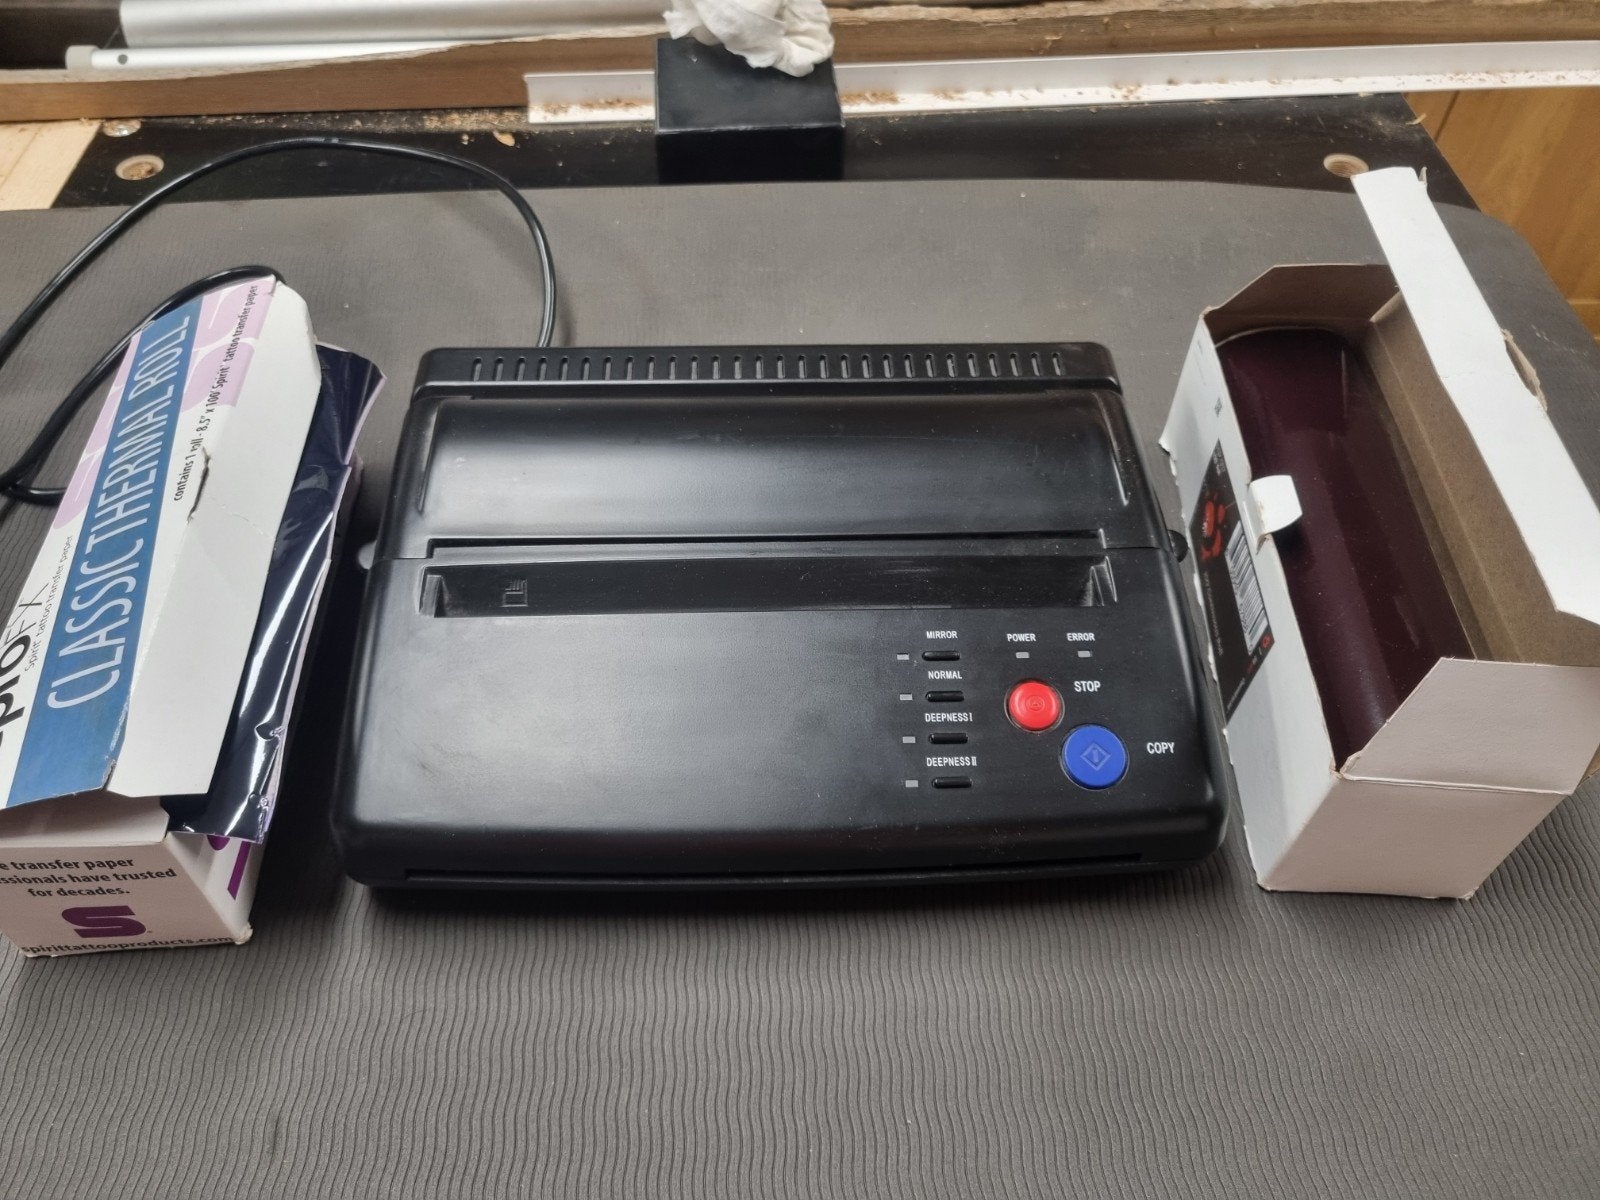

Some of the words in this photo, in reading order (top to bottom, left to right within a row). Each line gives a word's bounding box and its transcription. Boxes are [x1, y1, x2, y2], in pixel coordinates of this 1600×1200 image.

[243, 285, 258, 309] paper
[232, 308, 250, 338] transfer
[224, 335, 241, 362] tattoo
[128, 315, 191, 401] ROLL
[190, 439, 204, 453] roll
[86, 384, 175, 554] THERMAL
[174, 462, 194, 501] contains
[36, 603, 52, 636] tattoo
[47, 565, 64, 602] transfer
[60, 535, 73, 564] paper
[47, 538, 144, 709] CLASSIC
[926, 630, 958, 639] MIRROR
[1007, 633, 1036, 642] POWER
[1066, 632, 1095, 642] ERROR
[928, 670, 963, 680] NORMAL
[1074, 680, 1101, 693] STOP
[1146, 742, 1175, 755] COPY
[10, 859, 80, 870] transfer
[83, 857, 135, 870] paper
[67, 873, 110, 883] have
[113, 868, 177, 882] trusted
[27, 888, 53, 897] for
[56, 885, 130, 897] decades.
